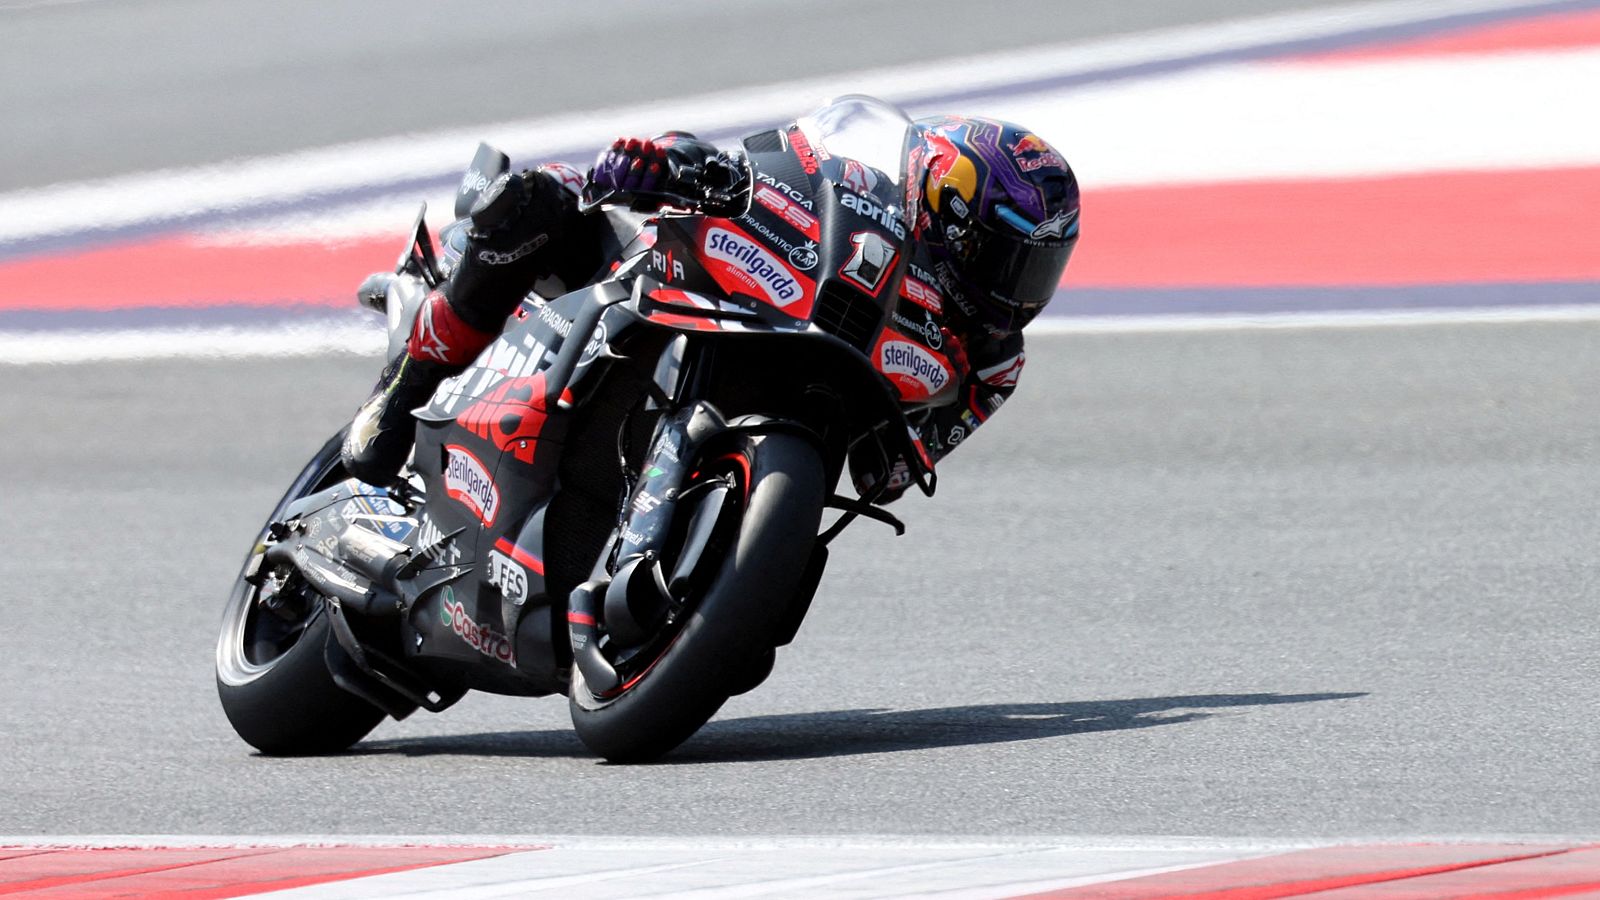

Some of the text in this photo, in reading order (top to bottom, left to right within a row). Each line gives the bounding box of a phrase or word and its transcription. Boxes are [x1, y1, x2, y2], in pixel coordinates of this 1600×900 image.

[755, 172, 814, 210] TARGA
[756, 188, 815, 228] BS
[742, 213, 793, 252] PRAGMATIC
[840, 193, 906, 241] aprilia
[709, 232, 795, 301] sterilgarda
[726, 263, 758, 290] alimenti
[791, 250, 815, 267] PLAY
[841, 231, 898, 294] 1
[905, 278, 942, 309] BS
[539, 305, 574, 337] PRAGMAT
[884, 345, 944, 389] sterilgarda
